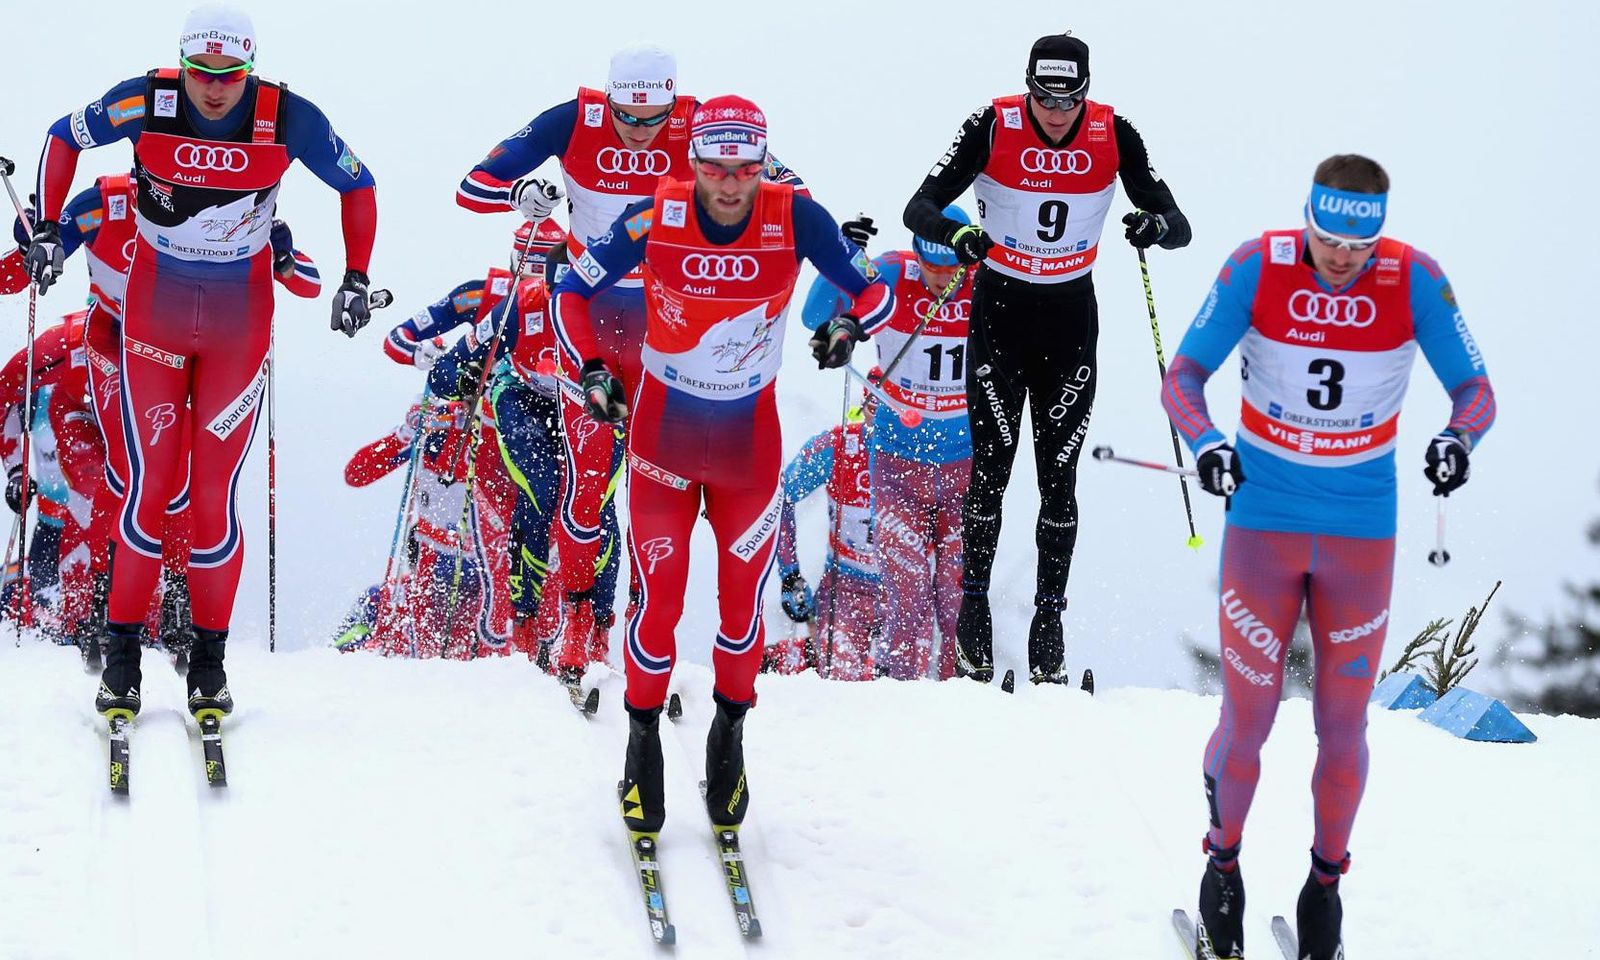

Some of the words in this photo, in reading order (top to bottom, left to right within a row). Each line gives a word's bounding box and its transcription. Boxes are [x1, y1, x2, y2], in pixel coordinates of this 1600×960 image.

[612, 80, 663, 90] SpareBank
[256, 120, 274, 128] 10TH
[703, 132, 748, 144] SpareBank
[173, 172, 206, 184] Audi
[596, 179, 629, 190] Audi
[1020, 178, 1052, 188] Audi
[1319, 194, 1382, 218] LUKOIL
[1036, 200, 1069, 243] 9
[171, 243, 236, 257] OBERSTDORF
[1018, 242, 1075, 255] OBERSTDORF
[682, 284, 716, 295] Audi
[1286, 327, 1325, 343] Audi
[1453, 311, 1483, 371] LUKOIL
[132, 343, 173, 364] SPAR
[923, 343, 965, 381] 11
[679, 374, 746, 391] OBERSTDORF
[1306, 358, 1345, 411] 3
[213, 377, 264, 435] SpareBank
[982, 380, 1013, 446] swisscom
[1284, 411, 1358, 428] OBERSTDORF
[631, 455, 674, 484] SPAR
[736, 492, 784, 557] SpareBank
[1221, 588, 1282, 663] LUKOIL
[1329, 609, 1389, 644] SCANIA
